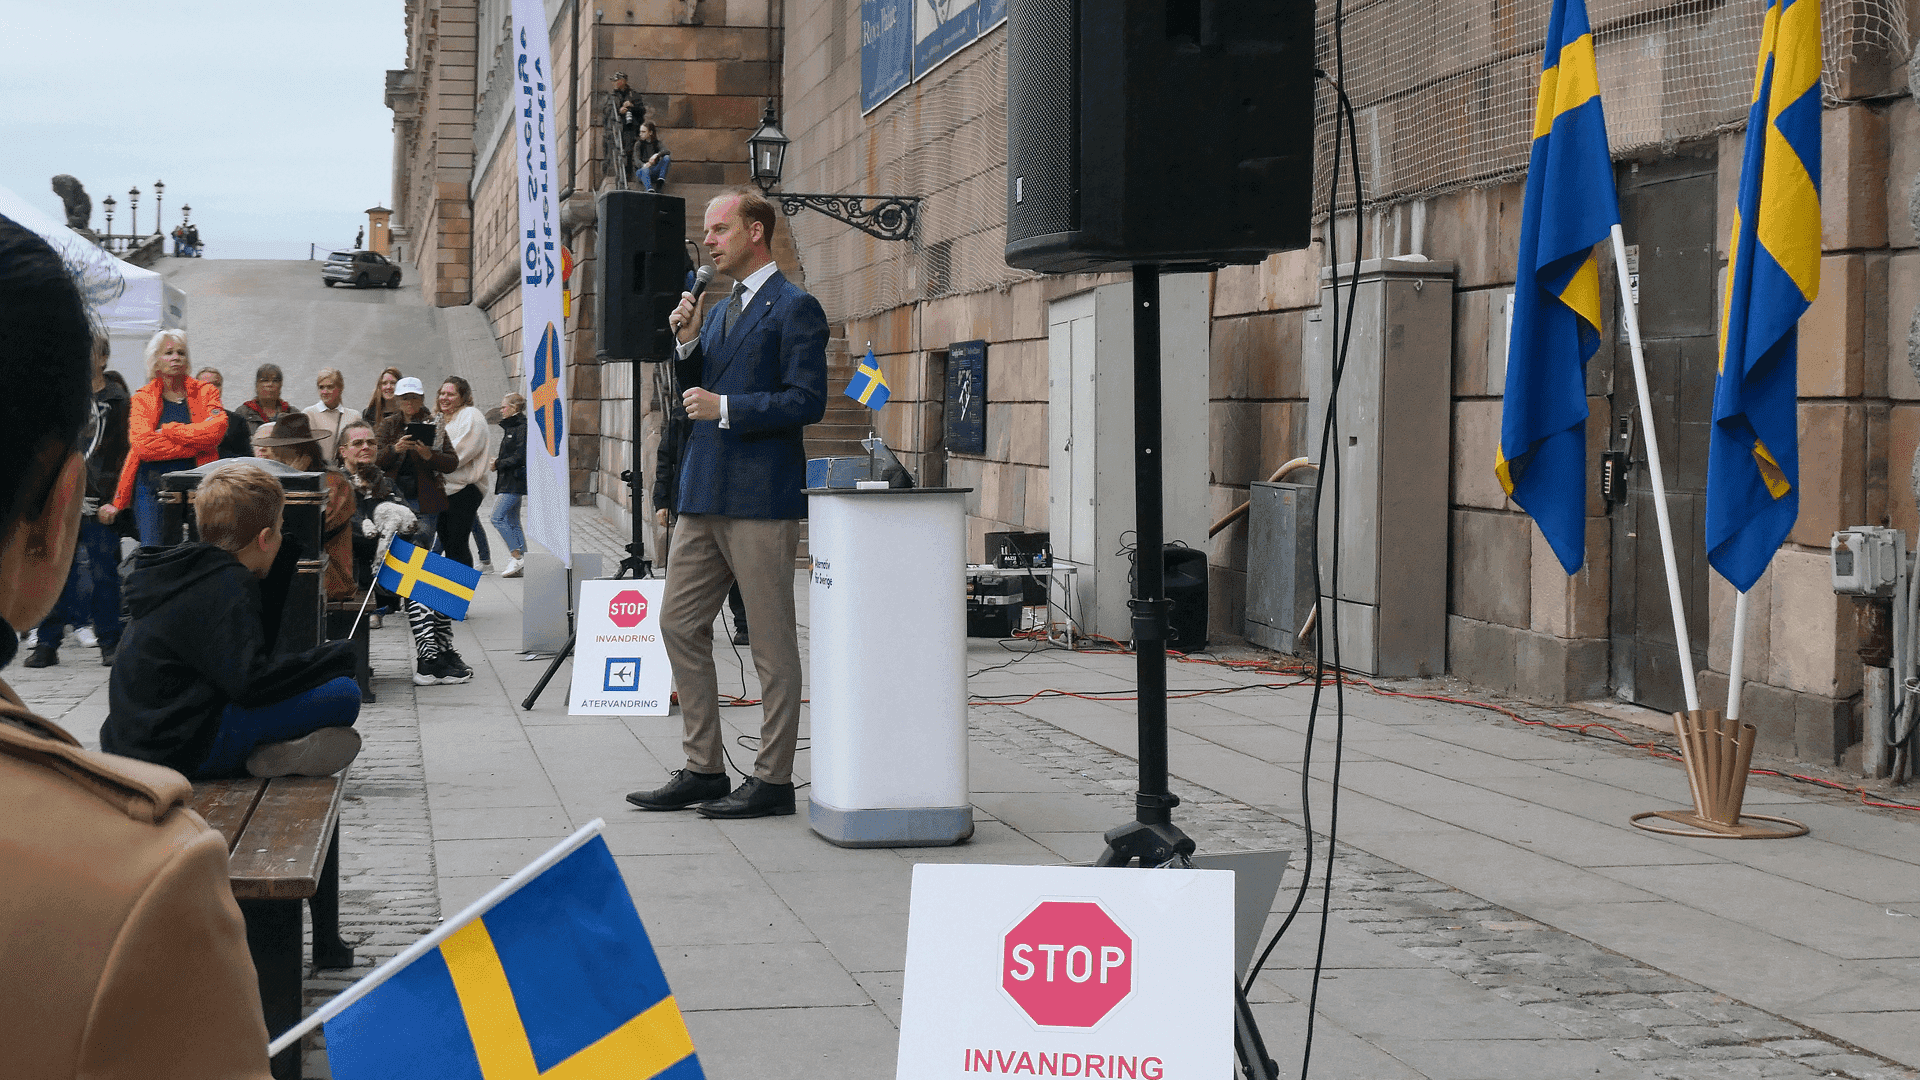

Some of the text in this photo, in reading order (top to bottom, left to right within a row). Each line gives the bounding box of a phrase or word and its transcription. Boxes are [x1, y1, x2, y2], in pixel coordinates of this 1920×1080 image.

[610, 602, 646, 615] STOP
[595, 634, 656, 643] INVANDRING
[1009, 943, 1126, 984] STOP
[964, 1048, 1163, 1080] INVANDRING
